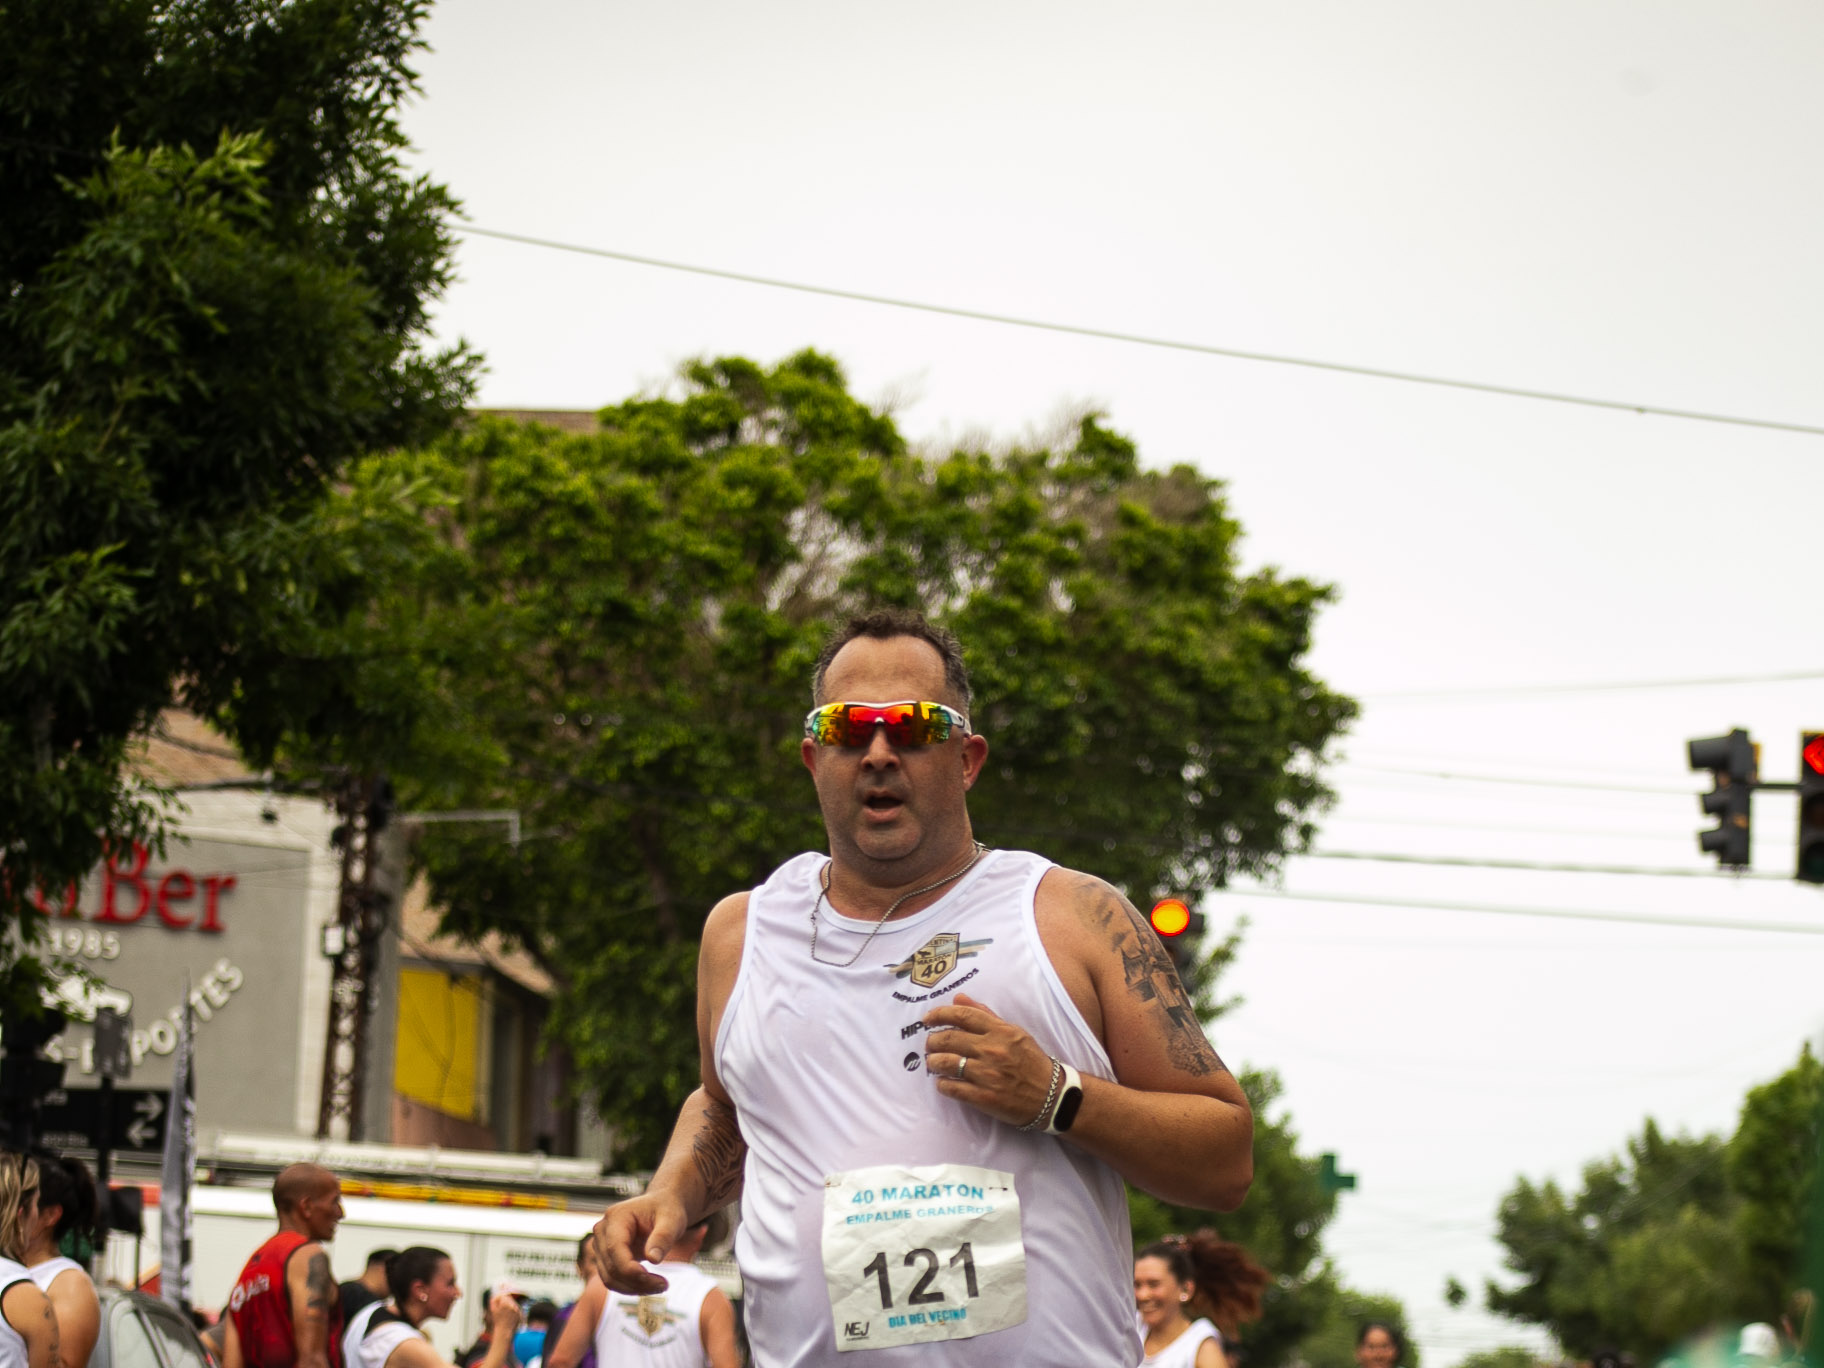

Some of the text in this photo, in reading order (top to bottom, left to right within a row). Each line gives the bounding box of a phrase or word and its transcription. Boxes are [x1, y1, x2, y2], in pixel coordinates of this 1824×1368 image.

[920, 960, 947, 980] 40
[929, 967, 980, 1000] GRANEROS
[852, 1184, 984, 1205] 40 MARATON
[846, 1204, 994, 1225] EMPALME GRANEROS
[863, 1241, 979, 1310] 121
[909, 1311, 928, 1326] DEL
[930, 1307, 967, 1324] VECINO
